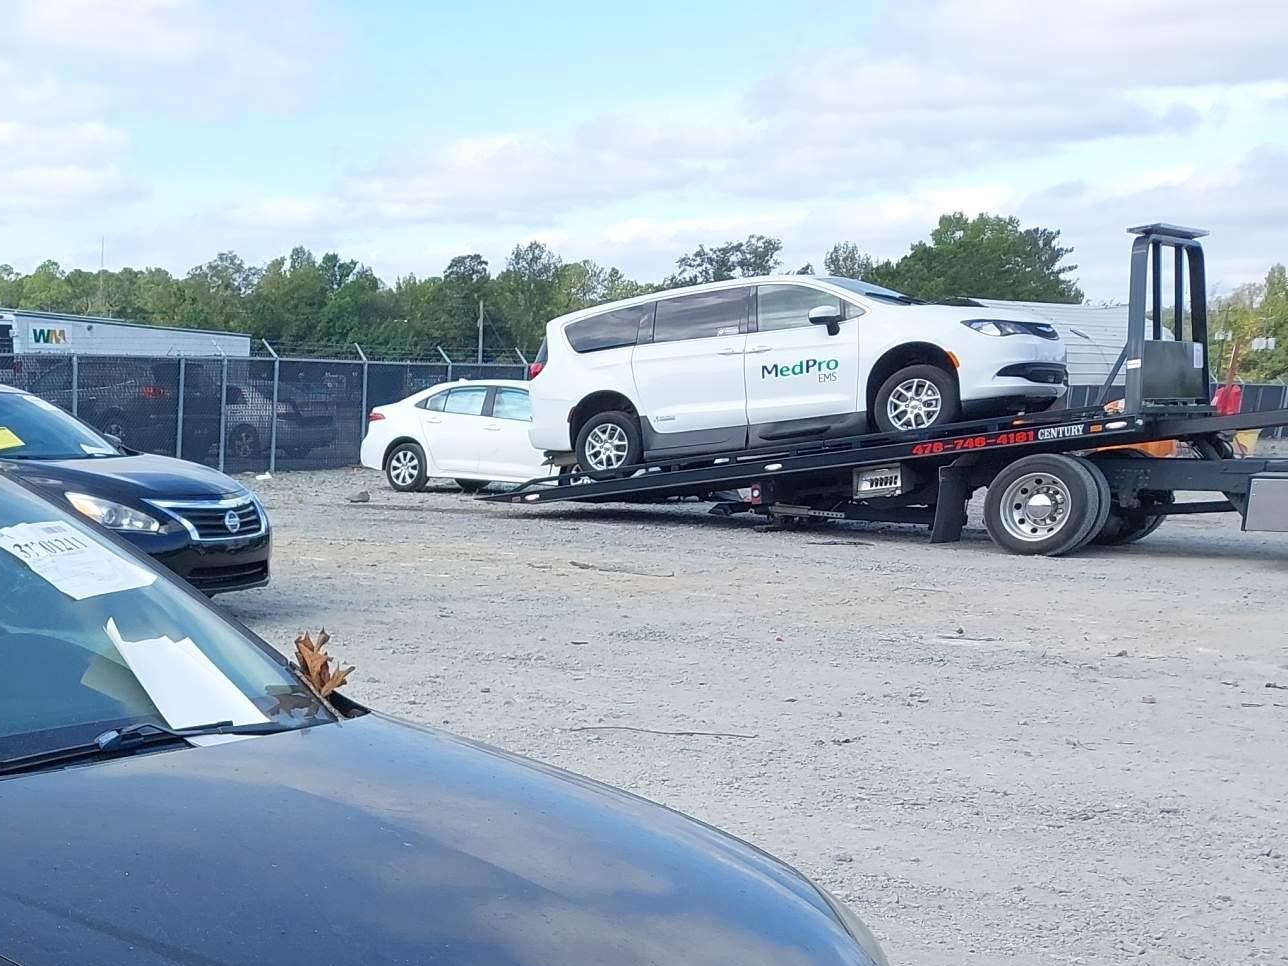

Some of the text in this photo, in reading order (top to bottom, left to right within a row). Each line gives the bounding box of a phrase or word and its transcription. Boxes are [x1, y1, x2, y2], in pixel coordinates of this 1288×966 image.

[33, 328, 66, 344] WM
[761, 358, 839, 380] MedPro
[818, 372, 838, 383] EMS
[1037, 424, 1085, 440] CENTURY
